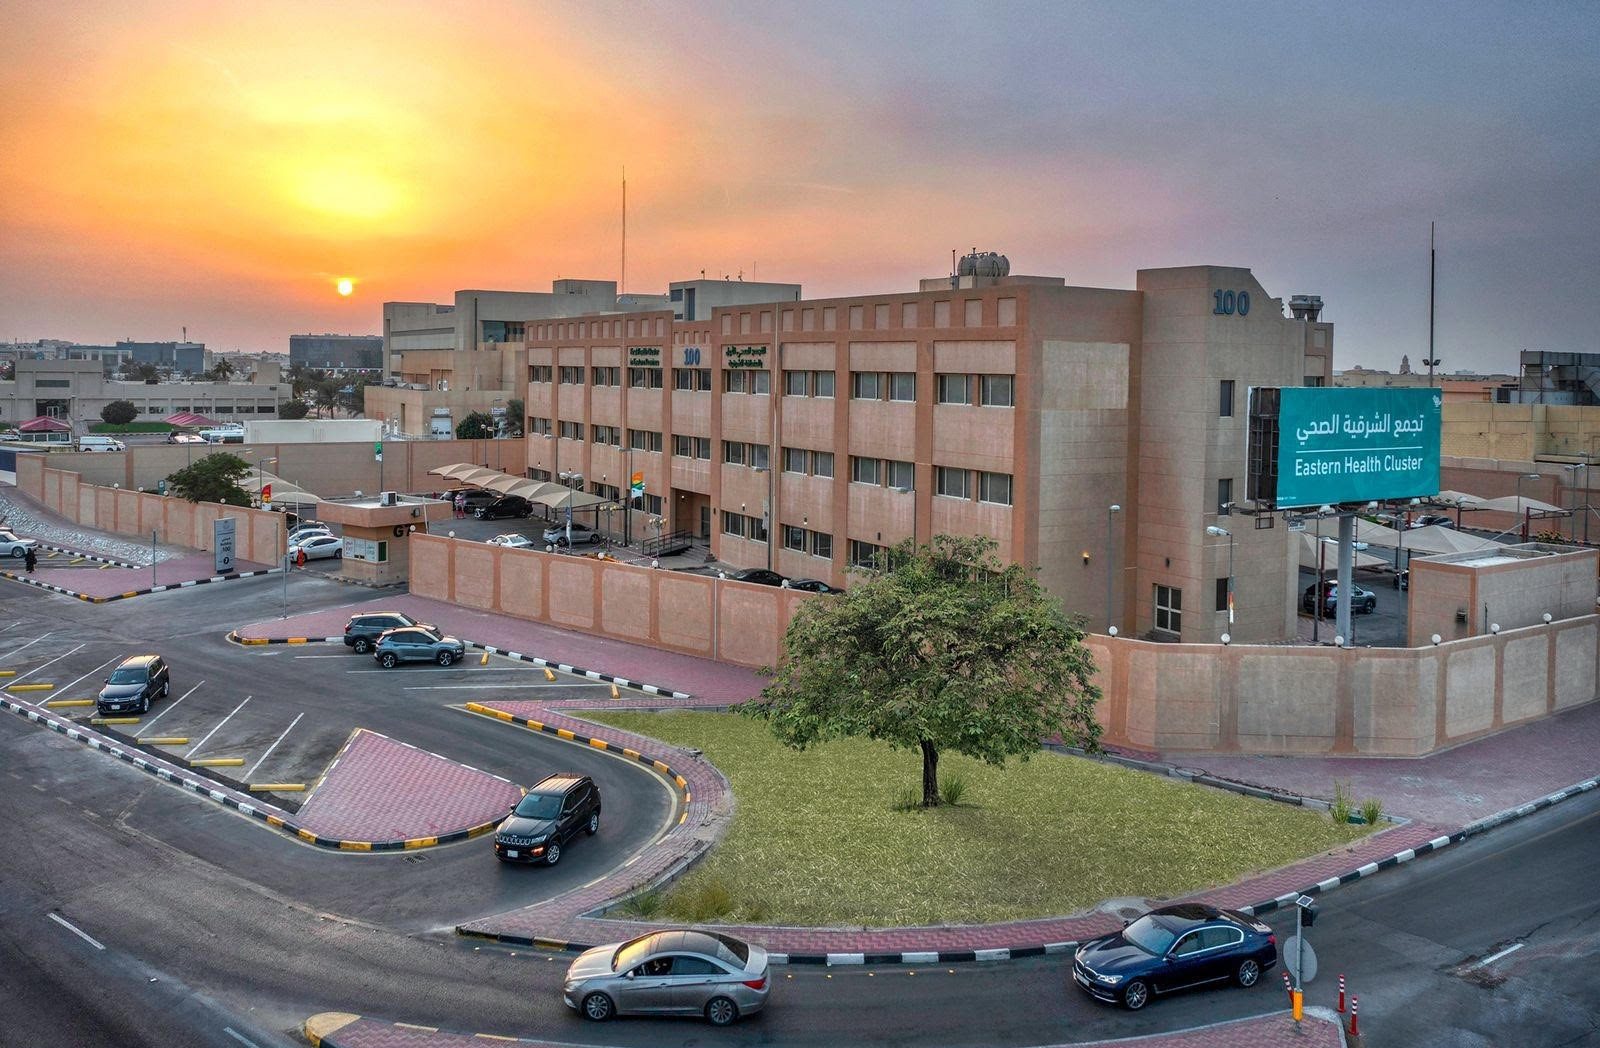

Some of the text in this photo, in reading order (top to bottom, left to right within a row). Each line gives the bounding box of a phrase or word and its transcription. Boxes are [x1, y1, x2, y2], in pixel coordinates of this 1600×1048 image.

[1213, 288, 1250, 316] 100
[683, 347, 701, 366] 100
[1295, 411, 1424, 446] تجمع الشرقية الصحي
[1295, 454, 1424, 477] Eastern Health Cluster
